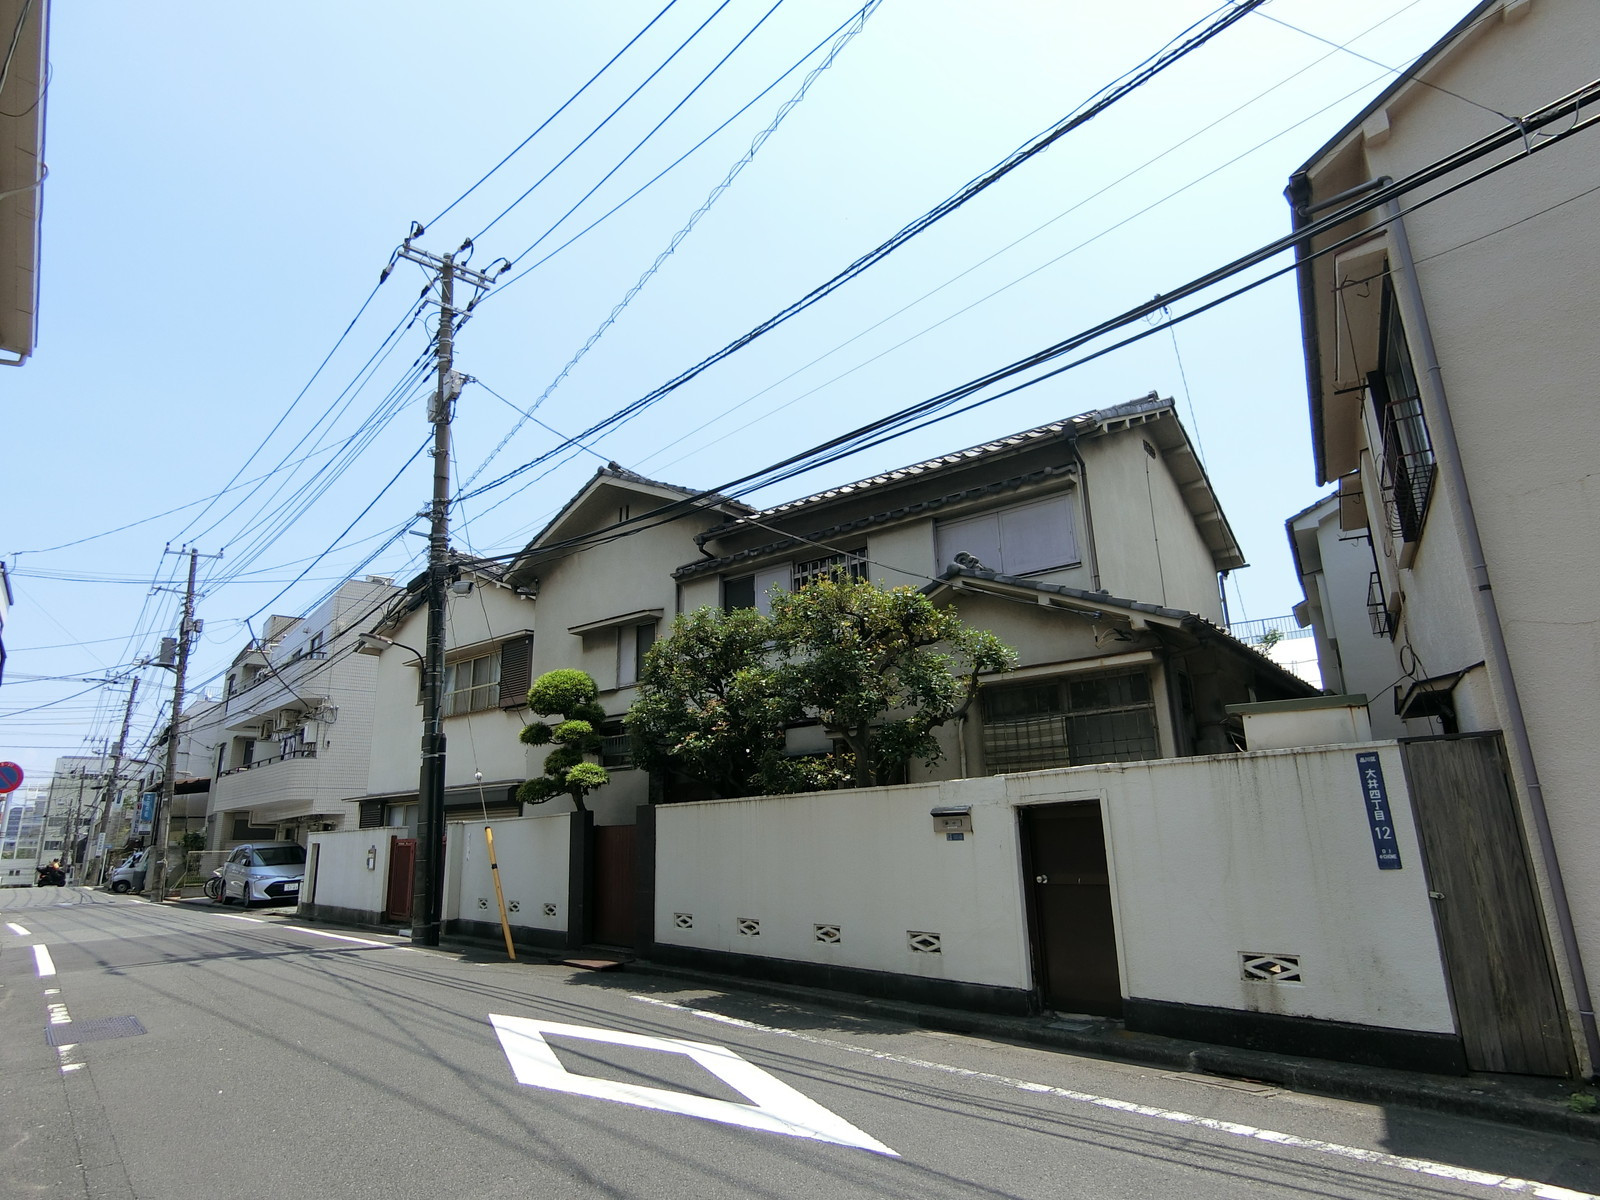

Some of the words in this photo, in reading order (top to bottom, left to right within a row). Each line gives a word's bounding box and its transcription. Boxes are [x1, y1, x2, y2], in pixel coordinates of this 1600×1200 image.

[1365, 768, 1385, 821] 大井四丁目
[1375, 826, 1392, 840] 12
